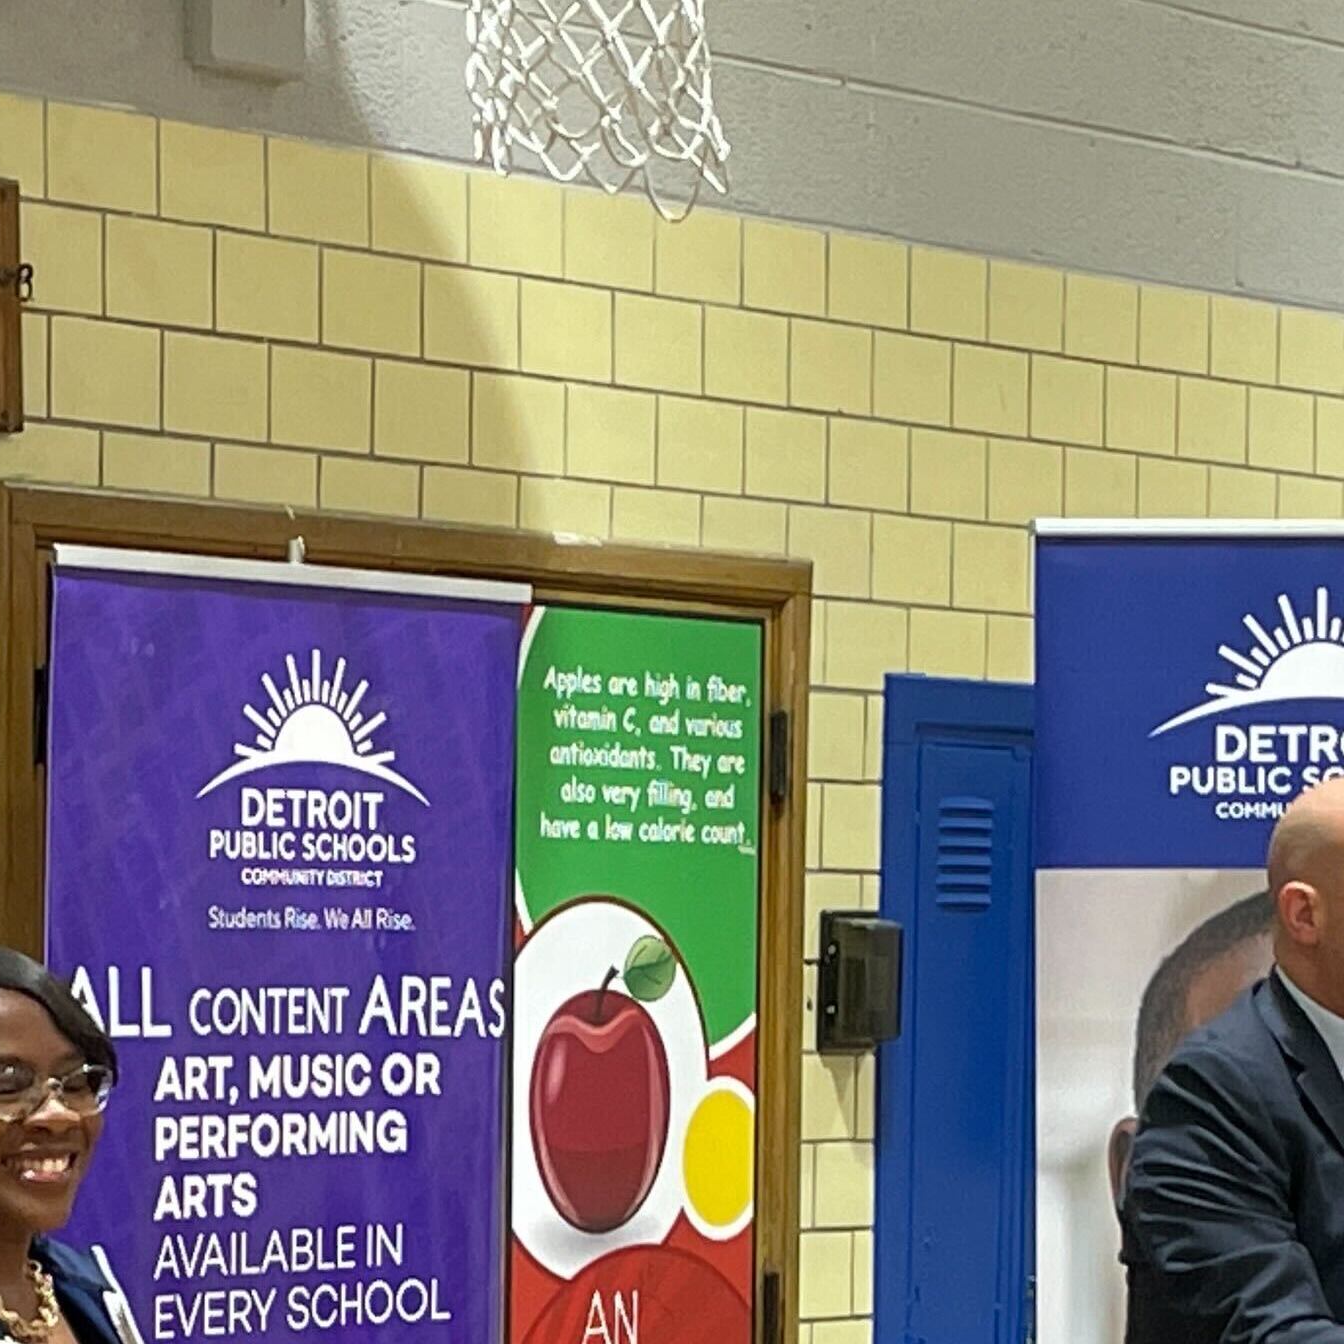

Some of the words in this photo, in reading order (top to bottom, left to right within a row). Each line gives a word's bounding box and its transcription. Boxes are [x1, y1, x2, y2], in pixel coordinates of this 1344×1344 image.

[544, 665, 602, 699] Apples
[608, 676, 638, 696] are
[644, 670, 680, 706] high
[686, 675, 701, 701] in
[707, 674, 751, 707] fiber,
[553, 703, 617, 732] vitamin
[622, 707, 641, 736] C,
[649, 708, 680, 736] and
[685, 712, 743, 739] various
[550, 740, 662, 771] antioxidants.
[670, 745, 711, 780] They
[717, 755, 745, 774] are
[1169, 766, 1292, 795] PUBLIC
[241, 787, 384, 830] DETROIT
[560, 775, 596, 804] also
[602, 783, 640, 813] very
[705, 783, 735, 809] and
[210, 829, 296, 860] PUBLIC
[302, 832, 417, 863] SCHOOLS
[540, 811, 580, 838] have
[587, 821, 598, 840] a
[605, 813, 633, 841] low
[638, 815, 695, 843] calorie
[241, 867, 325, 887] COMMUNITY
[326, 869, 384, 888] DISTRICT
[208, 905, 281, 930] Students
[284, 907, 321, 930] Rise.
[323, 907, 350, 930] We
[351, 907, 373, 931] All
[376, 908, 416, 931] Rise.
[188, 987, 350, 1036] CONTENT
[358, 974, 506, 1038] AREAS
[153, 1055, 239, 1105] ART,
[248, 1053, 372, 1100] MUSIC
[380, 1052, 441, 1096] OR
[155, 1109, 408, 1161] PERFORMING
[153, 1172, 257, 1221] ARTS
[153, 1225, 357, 1281] AVAILABLE
[366, 1223, 403, 1267] IN
[155, 1287, 277, 1339] EVERY
[286, 1278, 451, 1331] SCHOOL
